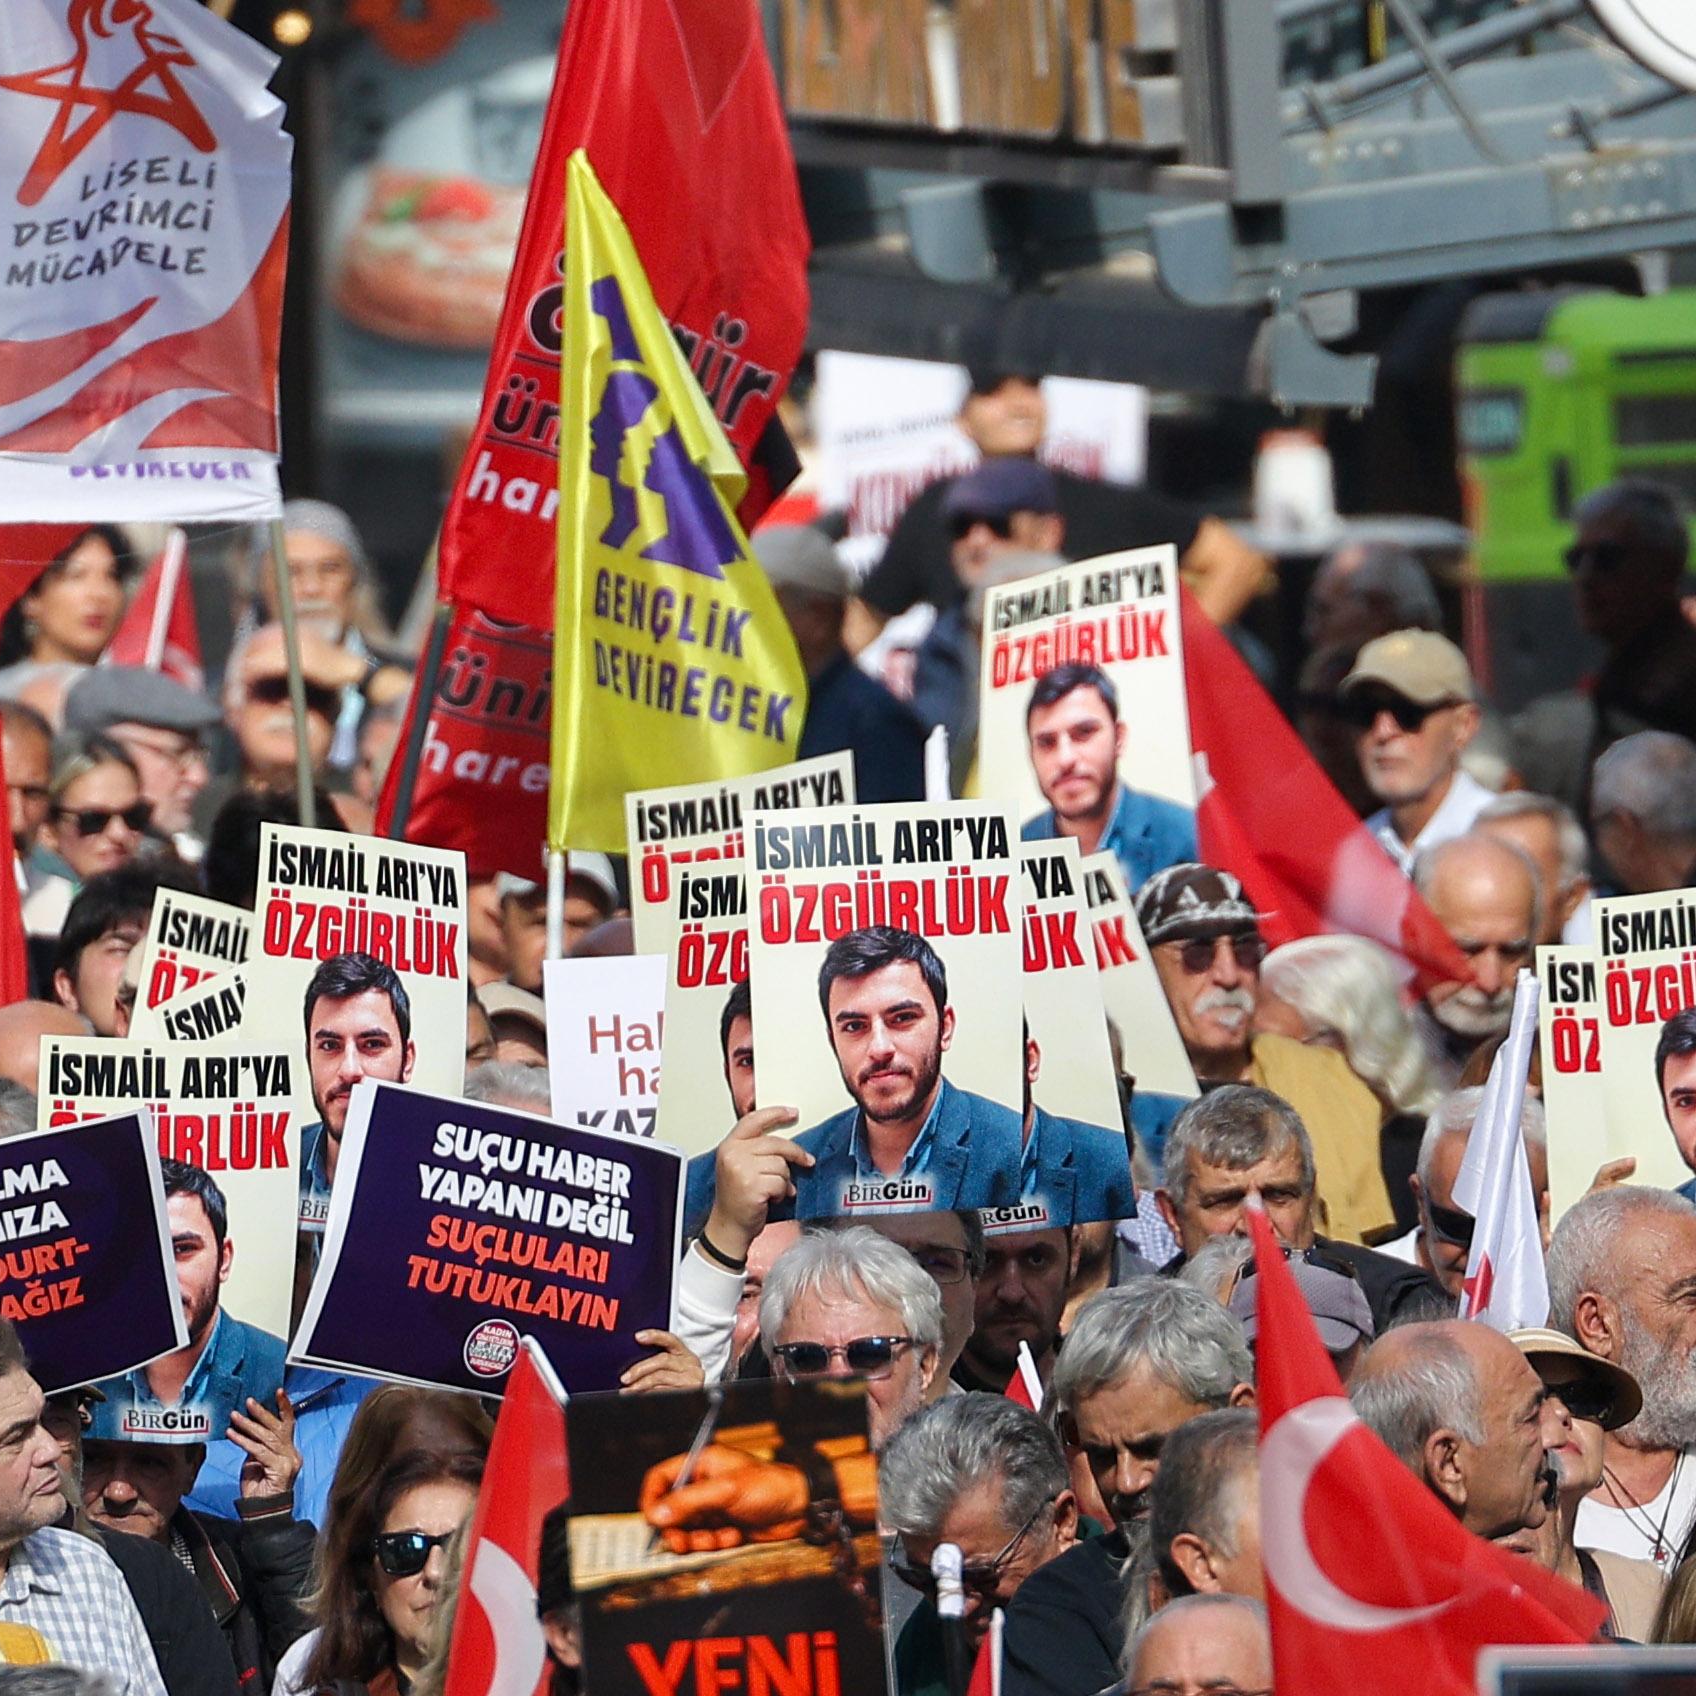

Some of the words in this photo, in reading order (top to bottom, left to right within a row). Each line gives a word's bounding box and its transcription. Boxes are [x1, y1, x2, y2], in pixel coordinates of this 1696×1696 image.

[13, 193, 214, 249] DEVRİMCİ
[6, 237, 208, 288] MÜCADELE
[993, 574, 1073, 632] İSMAİL
[992, 604, 1169, 689] ÖZGÜRLÜK
[637, 788, 743, 842] İSMAİL
[755, 813, 884, 871] İSMAİL
[267, 833, 369, 894] İSMAİL
[263, 888, 460, 980] ÖZGÜRLÜK
[759, 865, 1011, 946] ÖZGÜRLÜK
[49, 1045, 171, 1098] İSMAİL
[433, 1122, 526, 1176] SUÇU
[527, 1142, 632, 1199] HABER
[418, 1163, 544, 1225] YAPANI
[546, 1195, 634, 1246] DEĞİL
[426, 1214, 611, 1284] SUÇLULARI
[407, 1255, 620, 1332] TUTUKLAYIN
